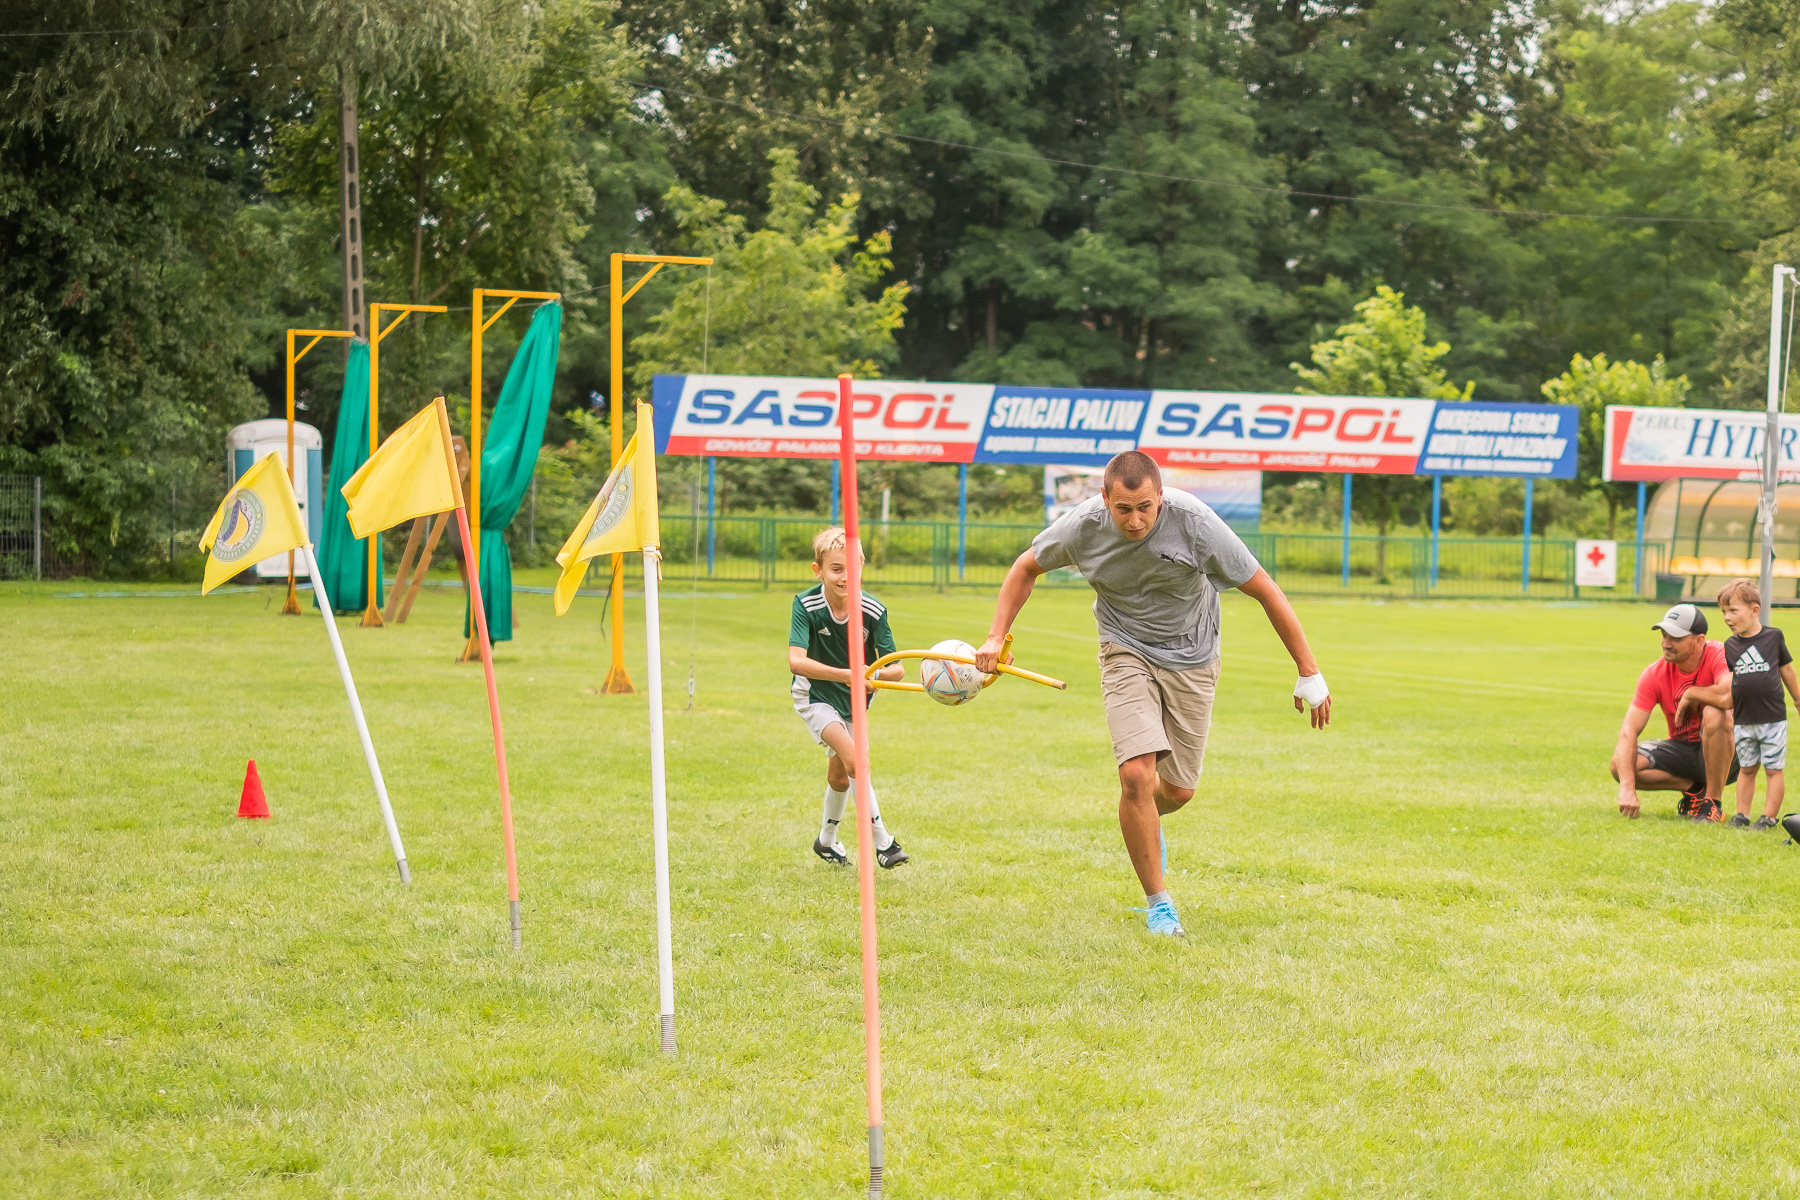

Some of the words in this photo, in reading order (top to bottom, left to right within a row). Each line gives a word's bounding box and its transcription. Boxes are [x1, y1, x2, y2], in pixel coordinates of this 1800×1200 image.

[686, 389, 970, 430] SASPOL
[991, 396, 1068, 430] STACJA
[1070, 398, 1144, 431] PALIW
[1156, 402, 1415, 444] SASPOL
[1734, 662, 1770, 674] adidas
